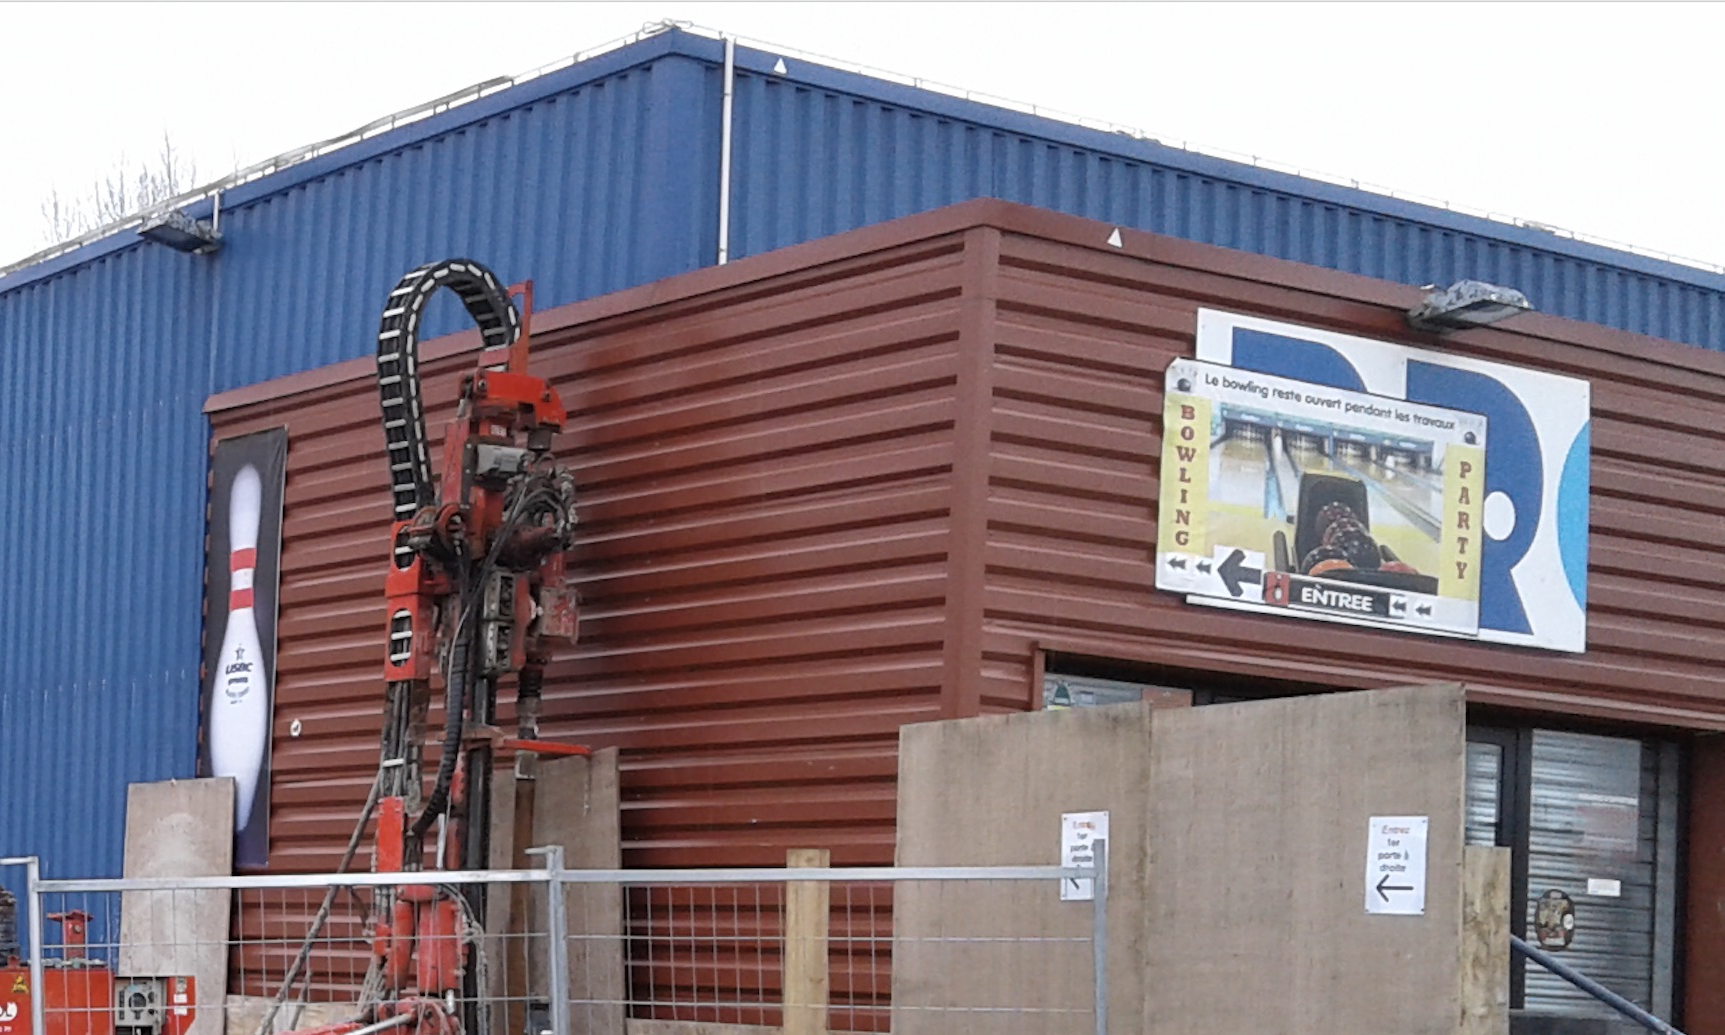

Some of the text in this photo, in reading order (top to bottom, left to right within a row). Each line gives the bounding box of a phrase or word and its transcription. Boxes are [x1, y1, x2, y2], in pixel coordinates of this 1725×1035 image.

[1205, 373, 1456, 431] Le bowling reste ouvert pendant les travaux
[1175, 404, 1196, 547] BOWLING
[1456, 461, 1472, 580] PARTY
